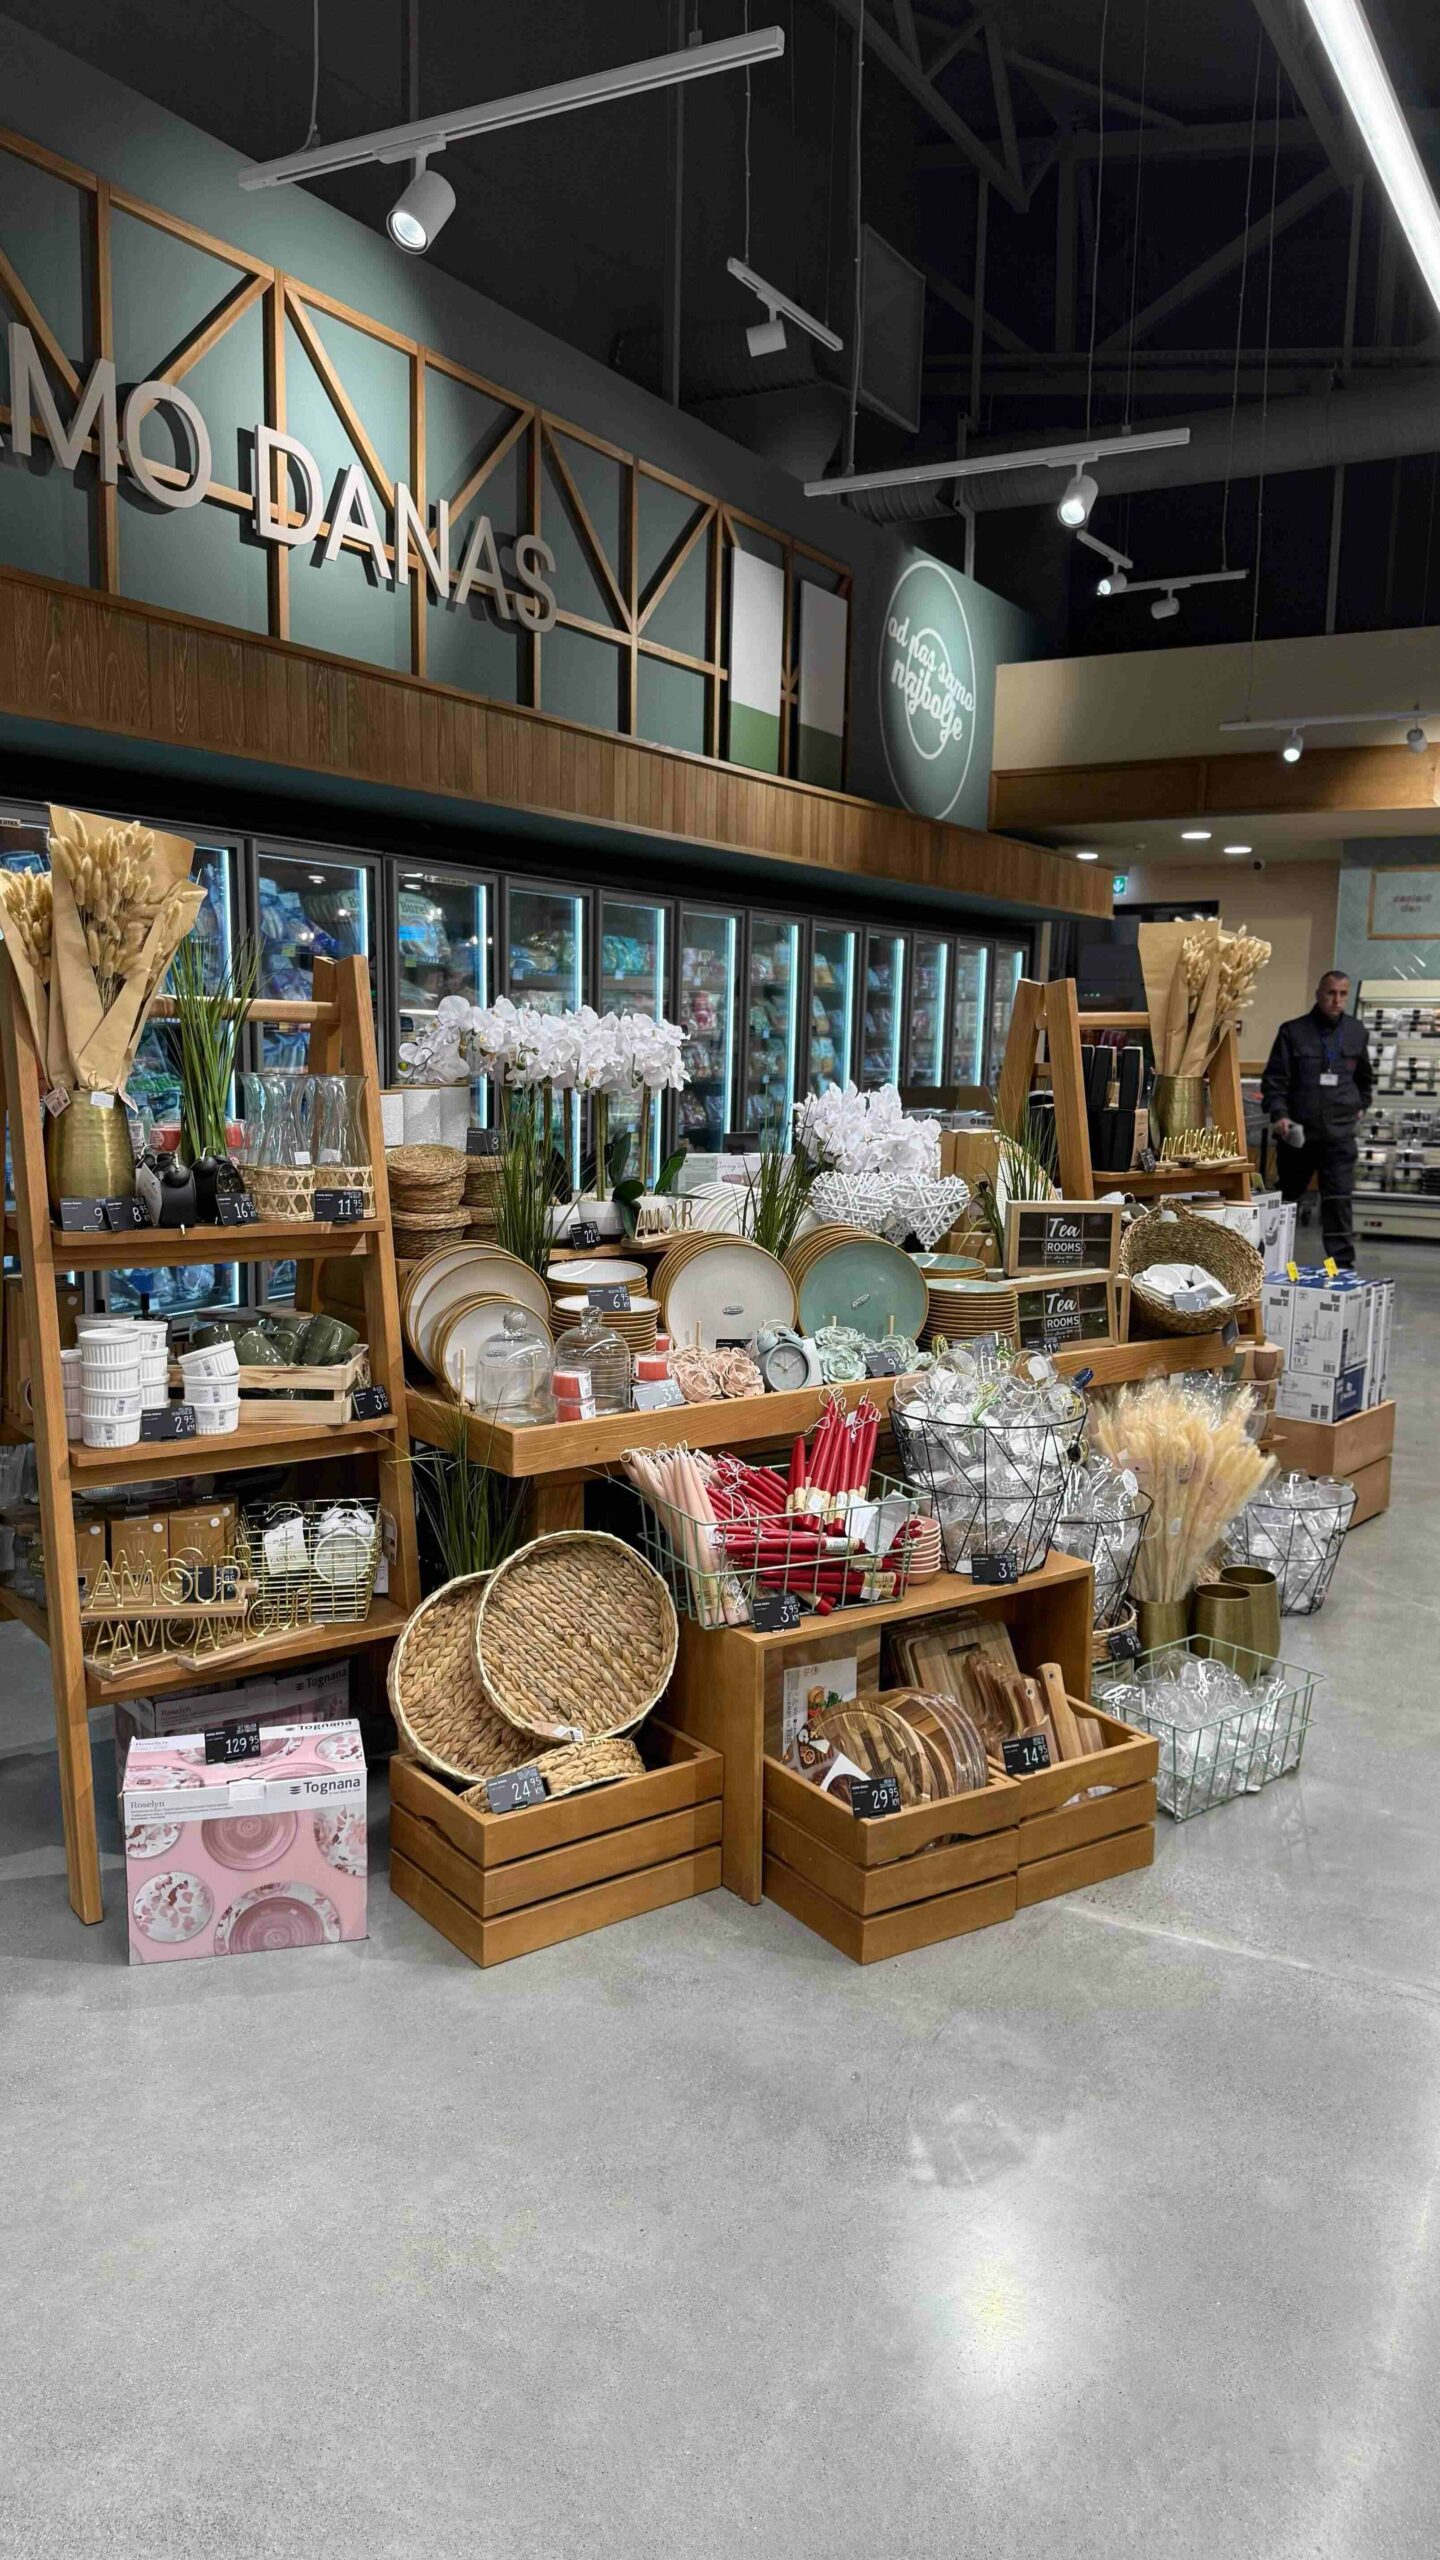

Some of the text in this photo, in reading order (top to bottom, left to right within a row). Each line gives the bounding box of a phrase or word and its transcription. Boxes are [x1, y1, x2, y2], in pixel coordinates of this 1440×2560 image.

[0, 322, 558, 633] MO DANAS
[887, 616, 975, 713] od nas samo
[891, 656, 963, 747] najbolje
[94, 1207, 103, 1224] 9
[132, 1206, 142, 1223] 8
[234, 1202, 248, 1219] 16
[338, 1198, 352, 1216] 11
[353, 1199, 363, 1208] 95
[635, 1199, 694, 1240] AMOUR
[1049, 1217, 1081, 1238] Tea
[584, 1229, 595, 1244] 22
[1047, 1242, 1082, 1252] ROOMS
[613, 1294, 621, 1309] 6
[1046, 1293, 1077, 1314] Tea
[1047, 1316, 1080, 1328] ROOMS
[374, 1395, 382, 1410] 3
[661, 1388, 672, 1402] 3
[174, 1416, 183, 1433] 2
[183, 1415, 194, 1424] 95
[998, 1562, 1007, 1579] 3
[1007, 1562, 1017, 1571] 95
[89, 1563, 244, 1608] AMOUR
[780, 1606, 789, 1623] 3
[788, 1604, 799, 1614] 95
[306, 1668, 348, 1690] Tognana
[298, 1720, 354, 1732] Tognana
[225, 1737, 248, 1754] 129
[248, 1735, 260, 1745] 95
[1023, 1746, 1039, 1766] 14
[1038, 1744, 1048, 1754] 95
[302, 1777, 361, 1796] Tognana
[511, 1780, 531, 1801] 24
[529, 1776, 542, 1787] 95
[130, 1800, 165, 1812] Roselyn
[871, 1789, 889, 1809] 29
[888, 1787, 899, 1798] 95
